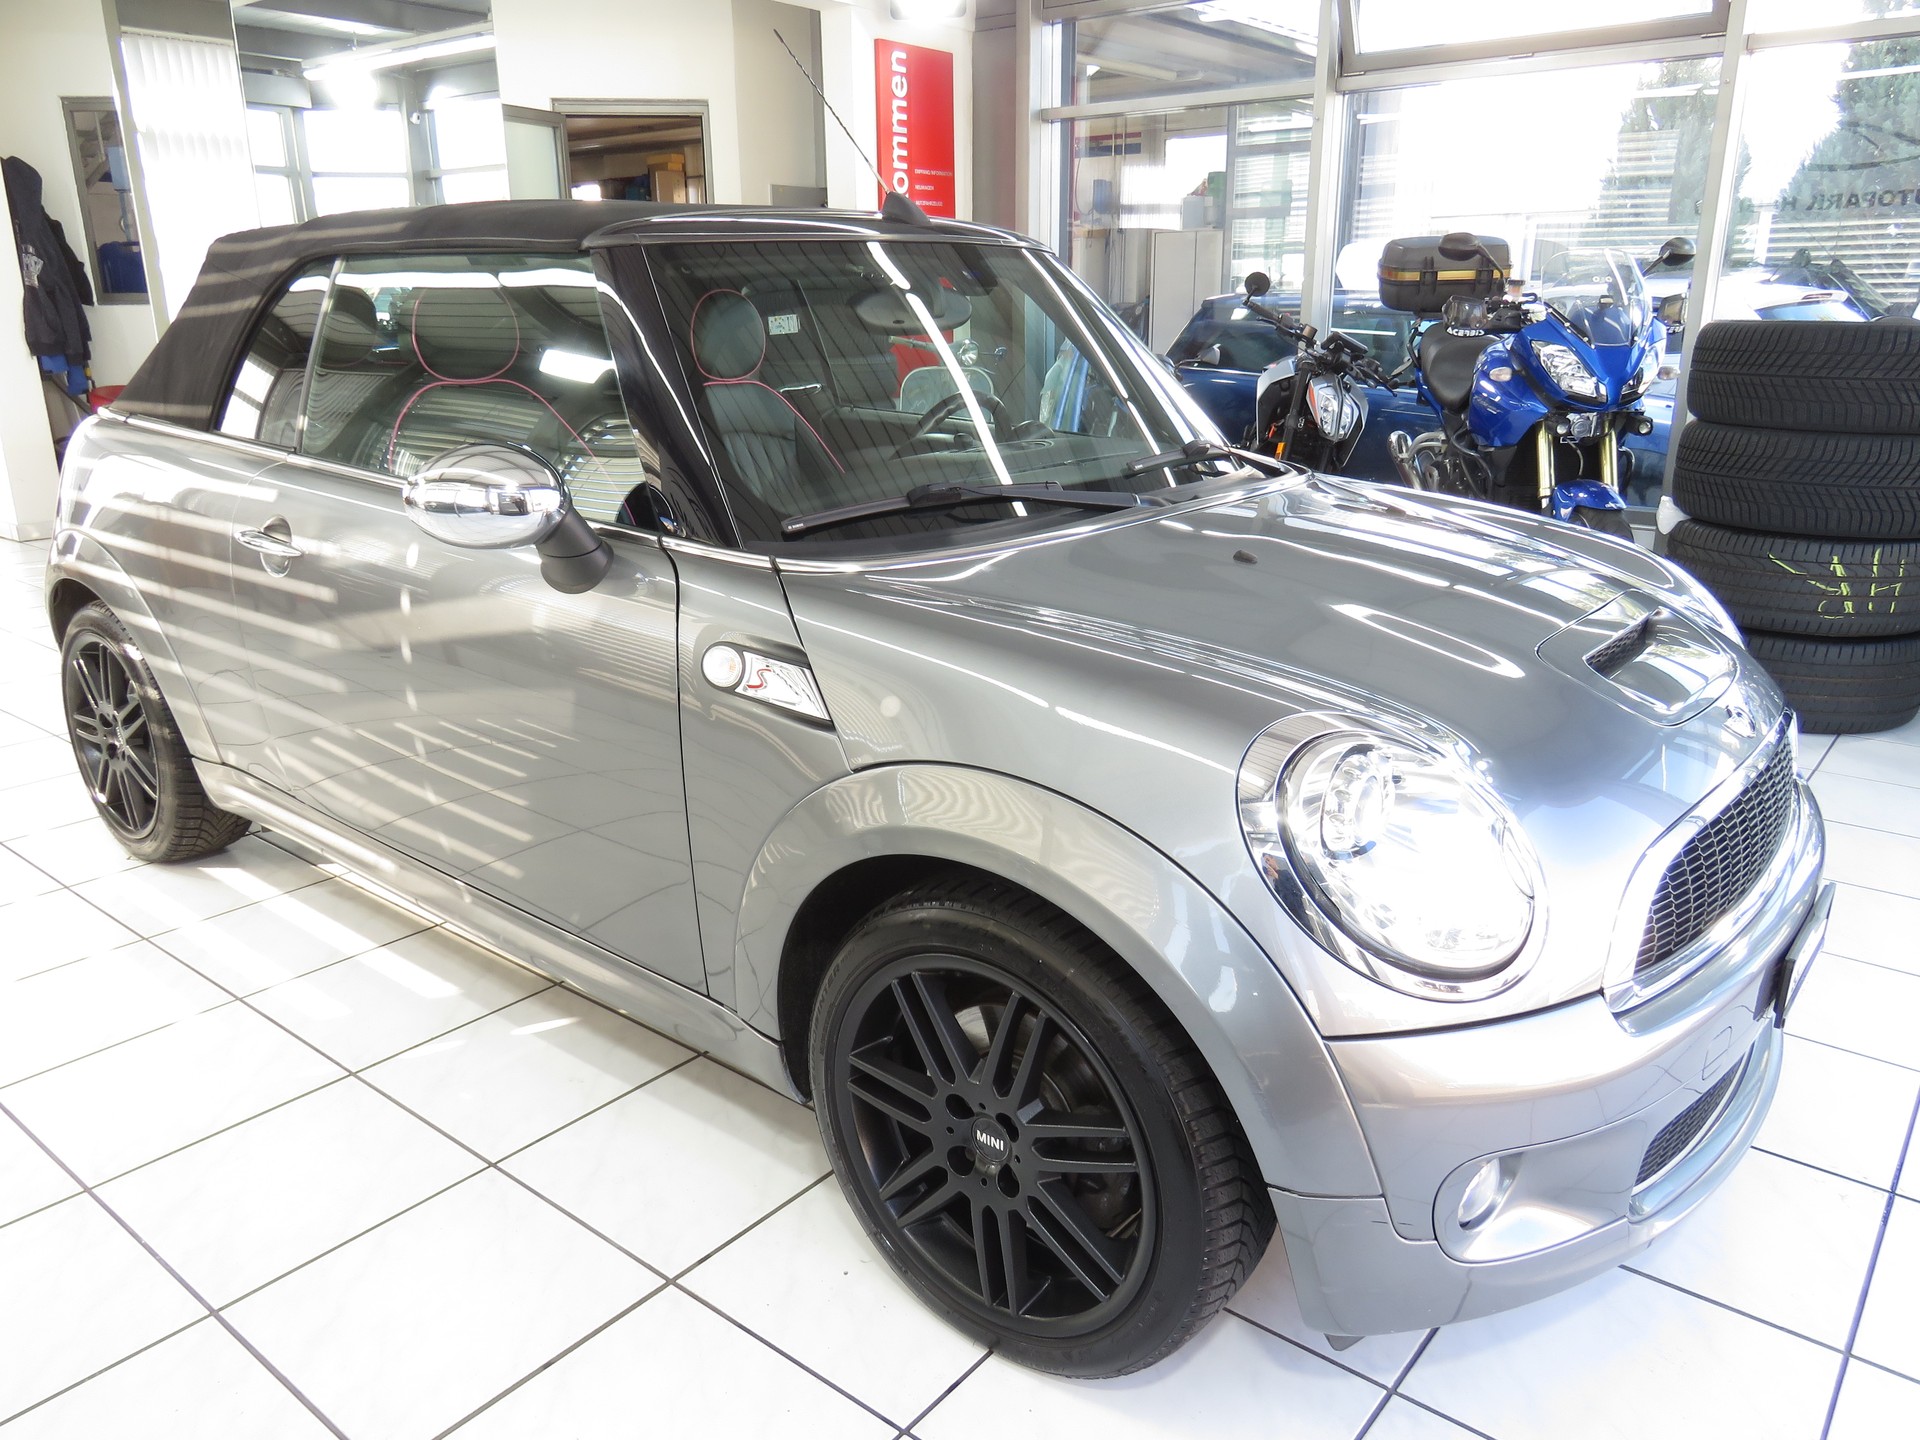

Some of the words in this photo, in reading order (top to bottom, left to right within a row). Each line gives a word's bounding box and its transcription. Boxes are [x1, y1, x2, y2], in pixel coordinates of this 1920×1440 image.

[890, 49, 910, 197] ommen
[745, 668, 772, 689] S
[976, 1129, 1004, 1151] MINI
